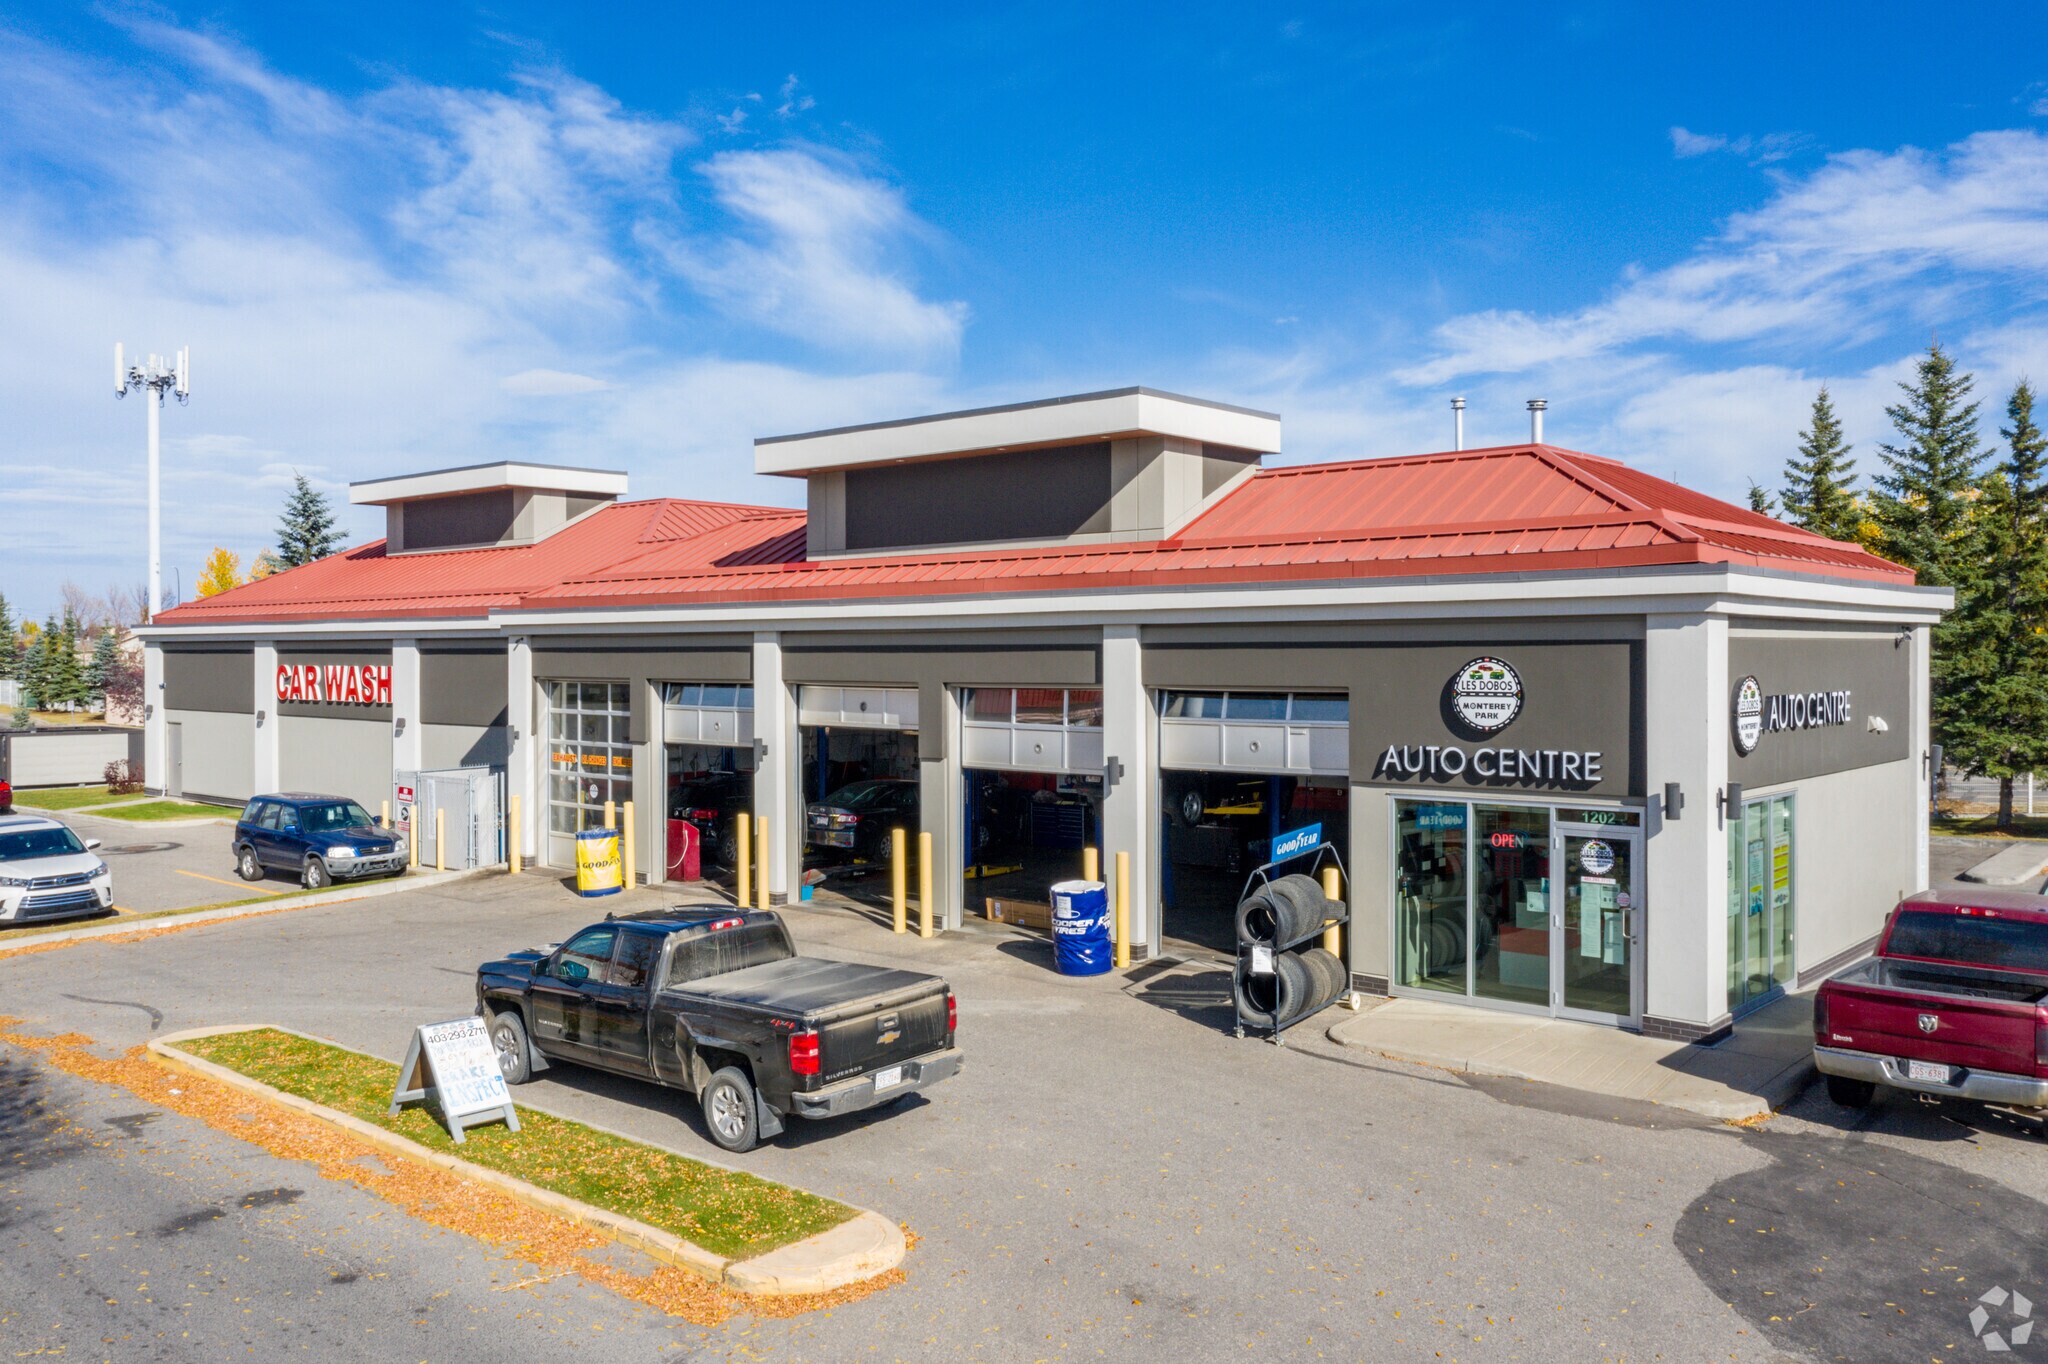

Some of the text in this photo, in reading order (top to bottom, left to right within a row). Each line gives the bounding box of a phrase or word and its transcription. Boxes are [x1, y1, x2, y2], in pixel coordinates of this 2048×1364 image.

[277, 664, 393, 704] CAR WASH
[1461, 680, 1513, 691] LES DOBOS
[1462, 702, 1512, 711] MONTEREY
[1769, 690, 1851, 730] AUTO CENTRE
[1474, 711, 1499, 720] PARK
[1382, 744, 1603, 781] AUTO CENTRE
[1582, 811, 1616, 825] 1202
[1276, 832, 1318, 855] GOODYEAR
[1491, 832, 1524, 849] OPEN
[1051, 918, 1095, 928] COOPER
[1055, 926, 1087, 935] TIRES
[825, 1065, 863, 1081] SILVERADO
[444, 1075, 506, 1107] INSPECT
